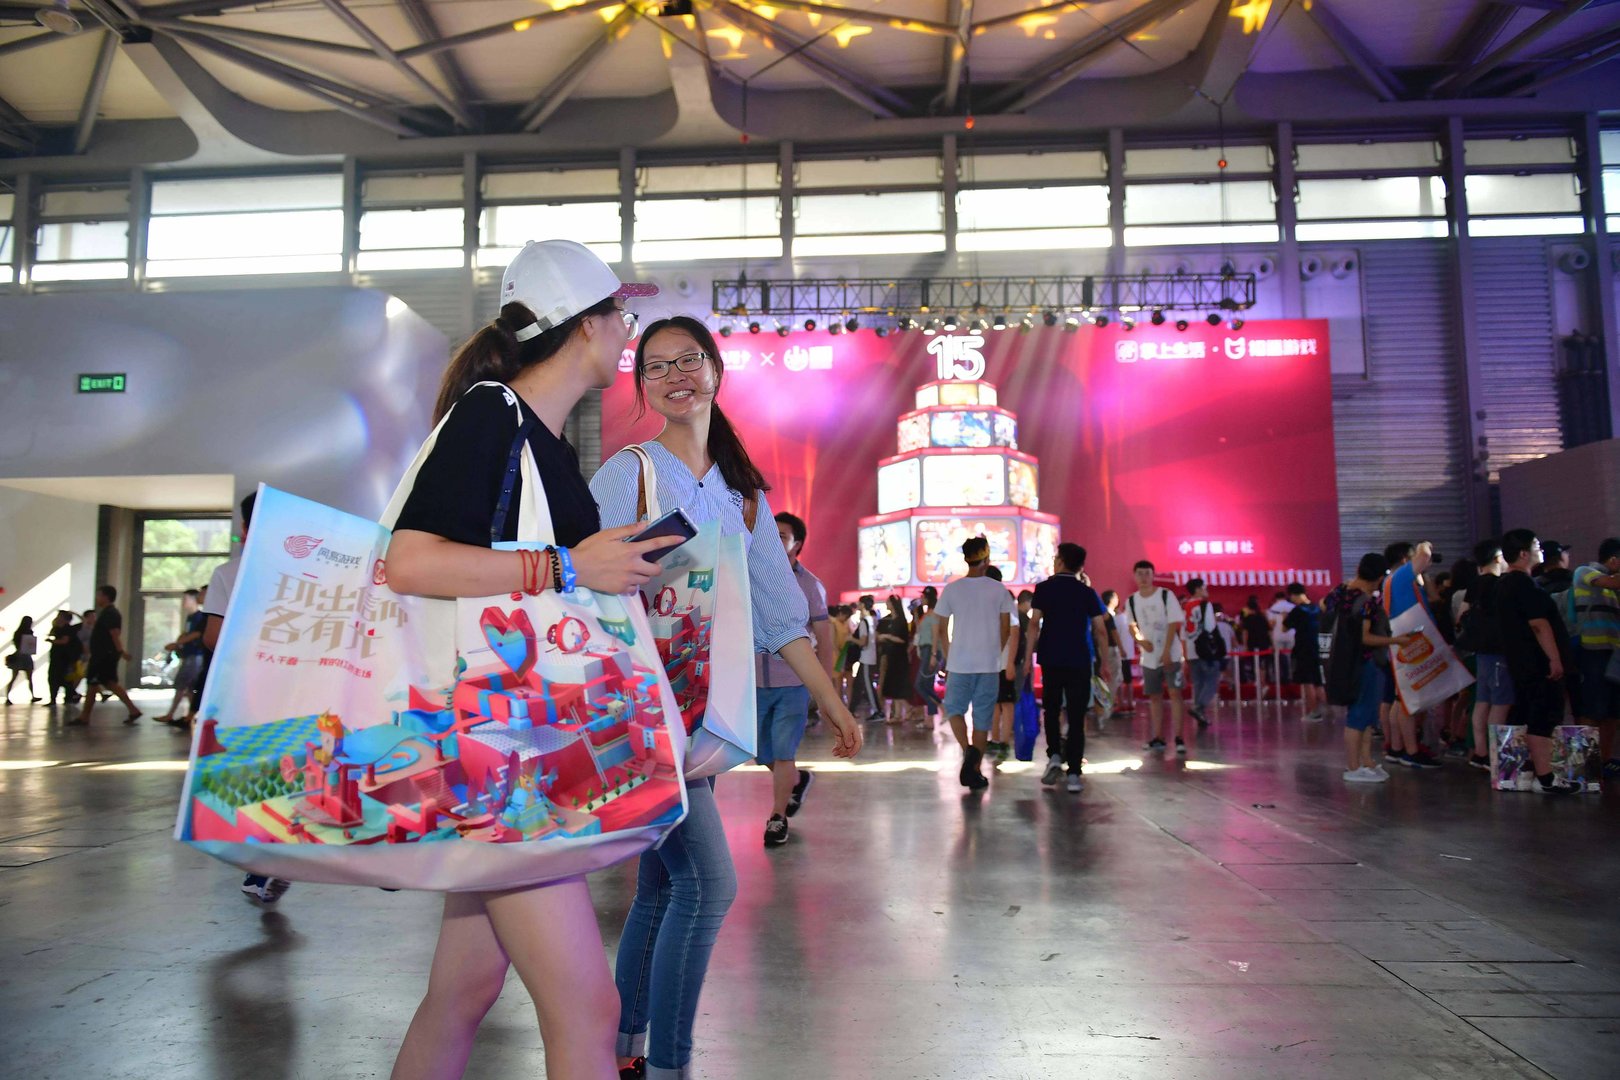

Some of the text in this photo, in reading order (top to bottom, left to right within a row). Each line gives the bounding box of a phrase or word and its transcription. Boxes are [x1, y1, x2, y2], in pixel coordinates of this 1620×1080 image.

[927, 334, 985, 380] 15
[91, 379, 113, 389] EXIT
[269, 572, 409, 628] 玩出信仰
